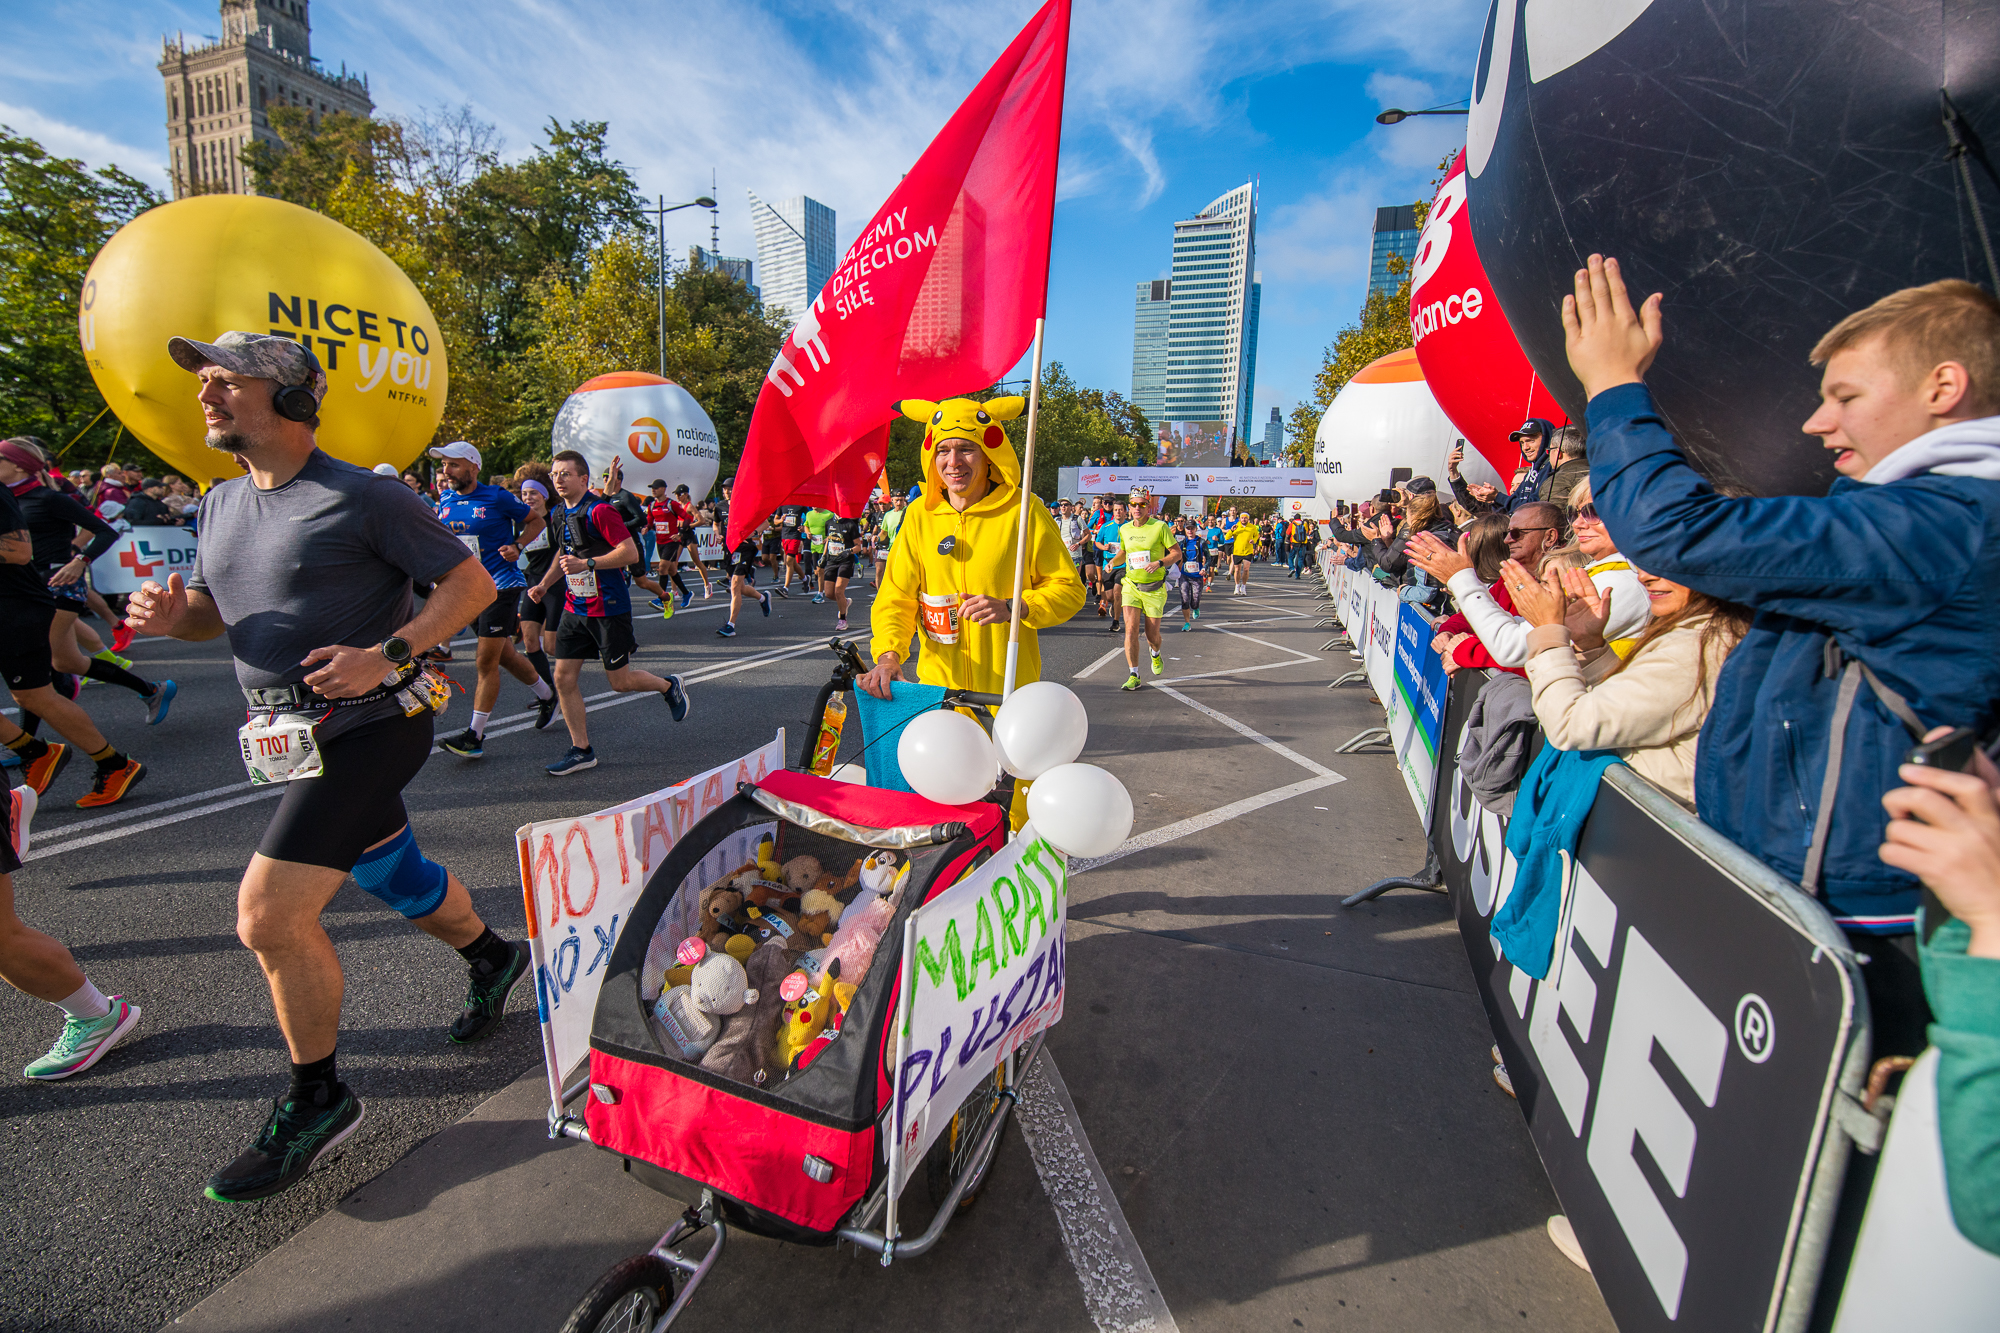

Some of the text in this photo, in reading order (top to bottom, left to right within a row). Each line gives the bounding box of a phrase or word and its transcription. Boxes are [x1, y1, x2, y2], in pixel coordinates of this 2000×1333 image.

[832, 225, 938, 297] DZIECIOM
[836, 281, 875, 320] SIŁĘ
[268, 291, 429, 356] NICE TO
[355, 343, 431, 392] you
[388, 389, 427, 407] NTFY.PL
[676, 427, 718, 446] nationale
[1230, 486, 1256, 494] 6:07
[256, 734, 289, 757] 7707
